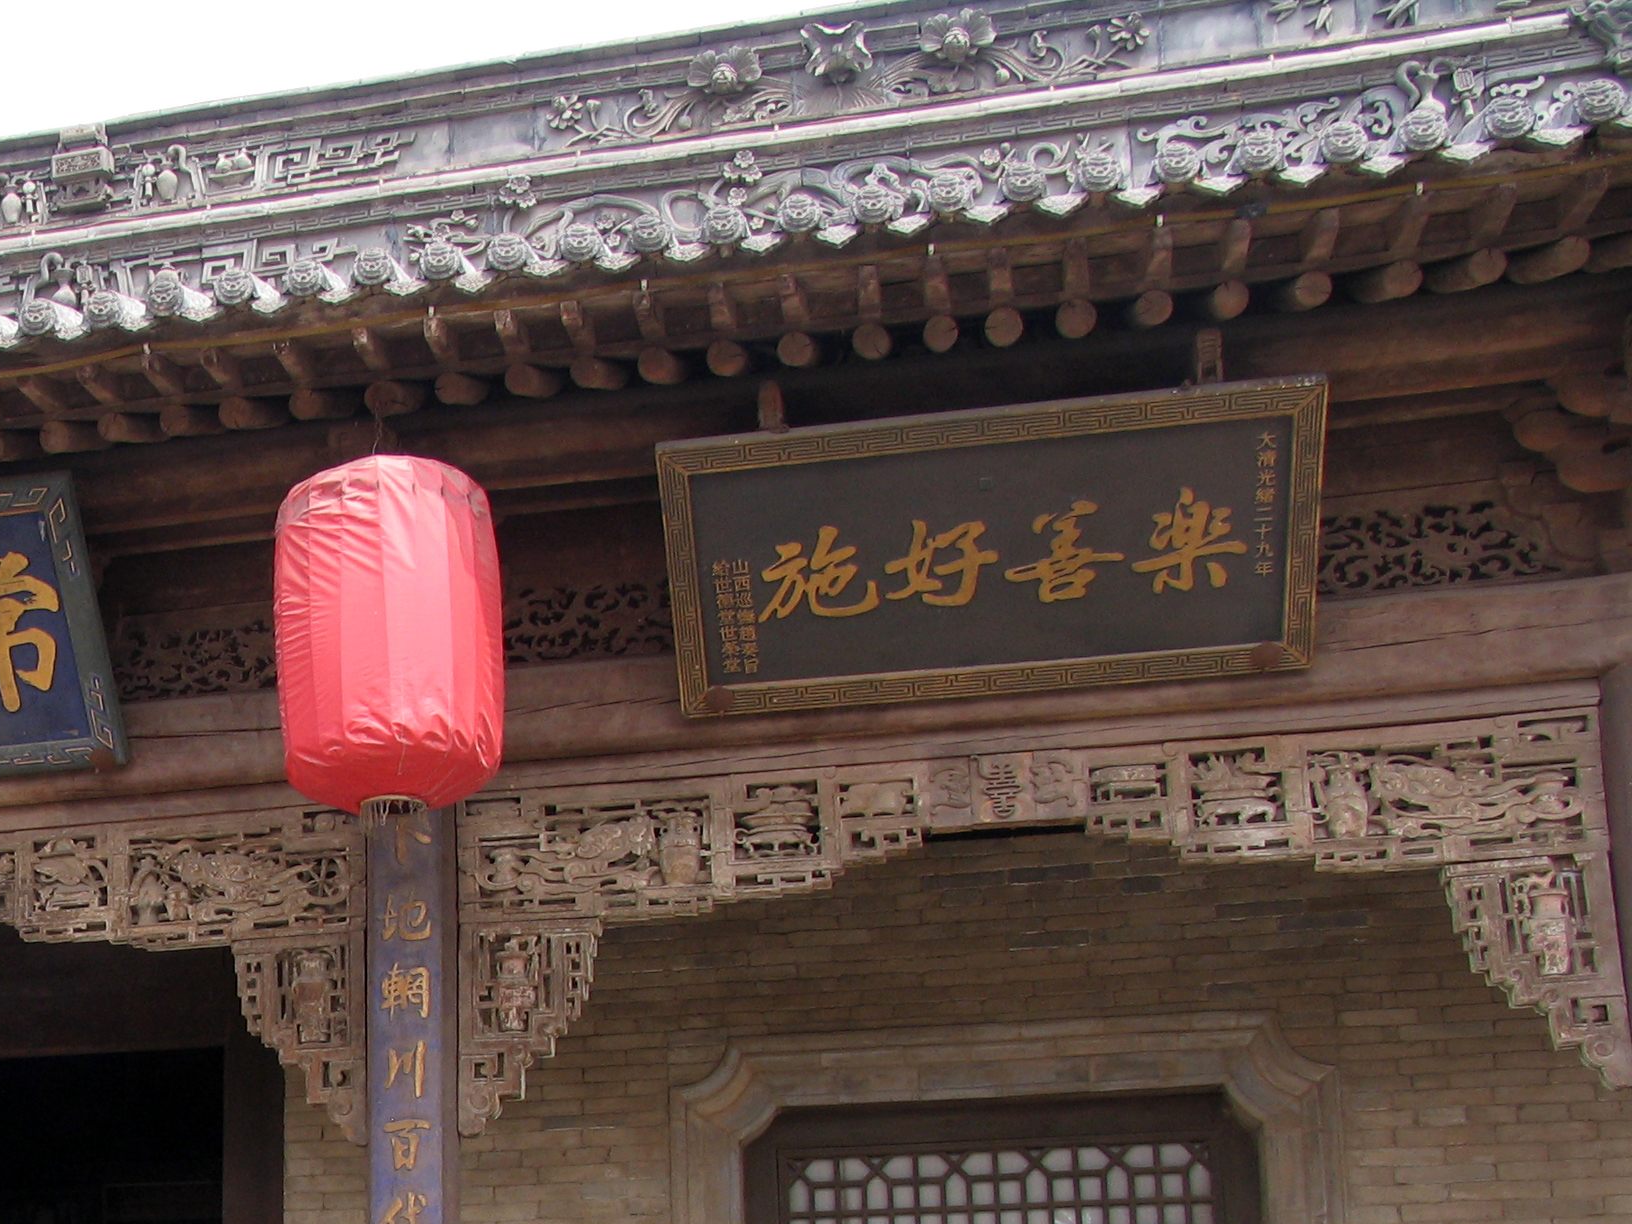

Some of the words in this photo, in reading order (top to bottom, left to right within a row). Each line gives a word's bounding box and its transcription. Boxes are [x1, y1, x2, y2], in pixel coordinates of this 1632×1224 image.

[1253, 432, 1279, 577] 大清光緒二十九年
